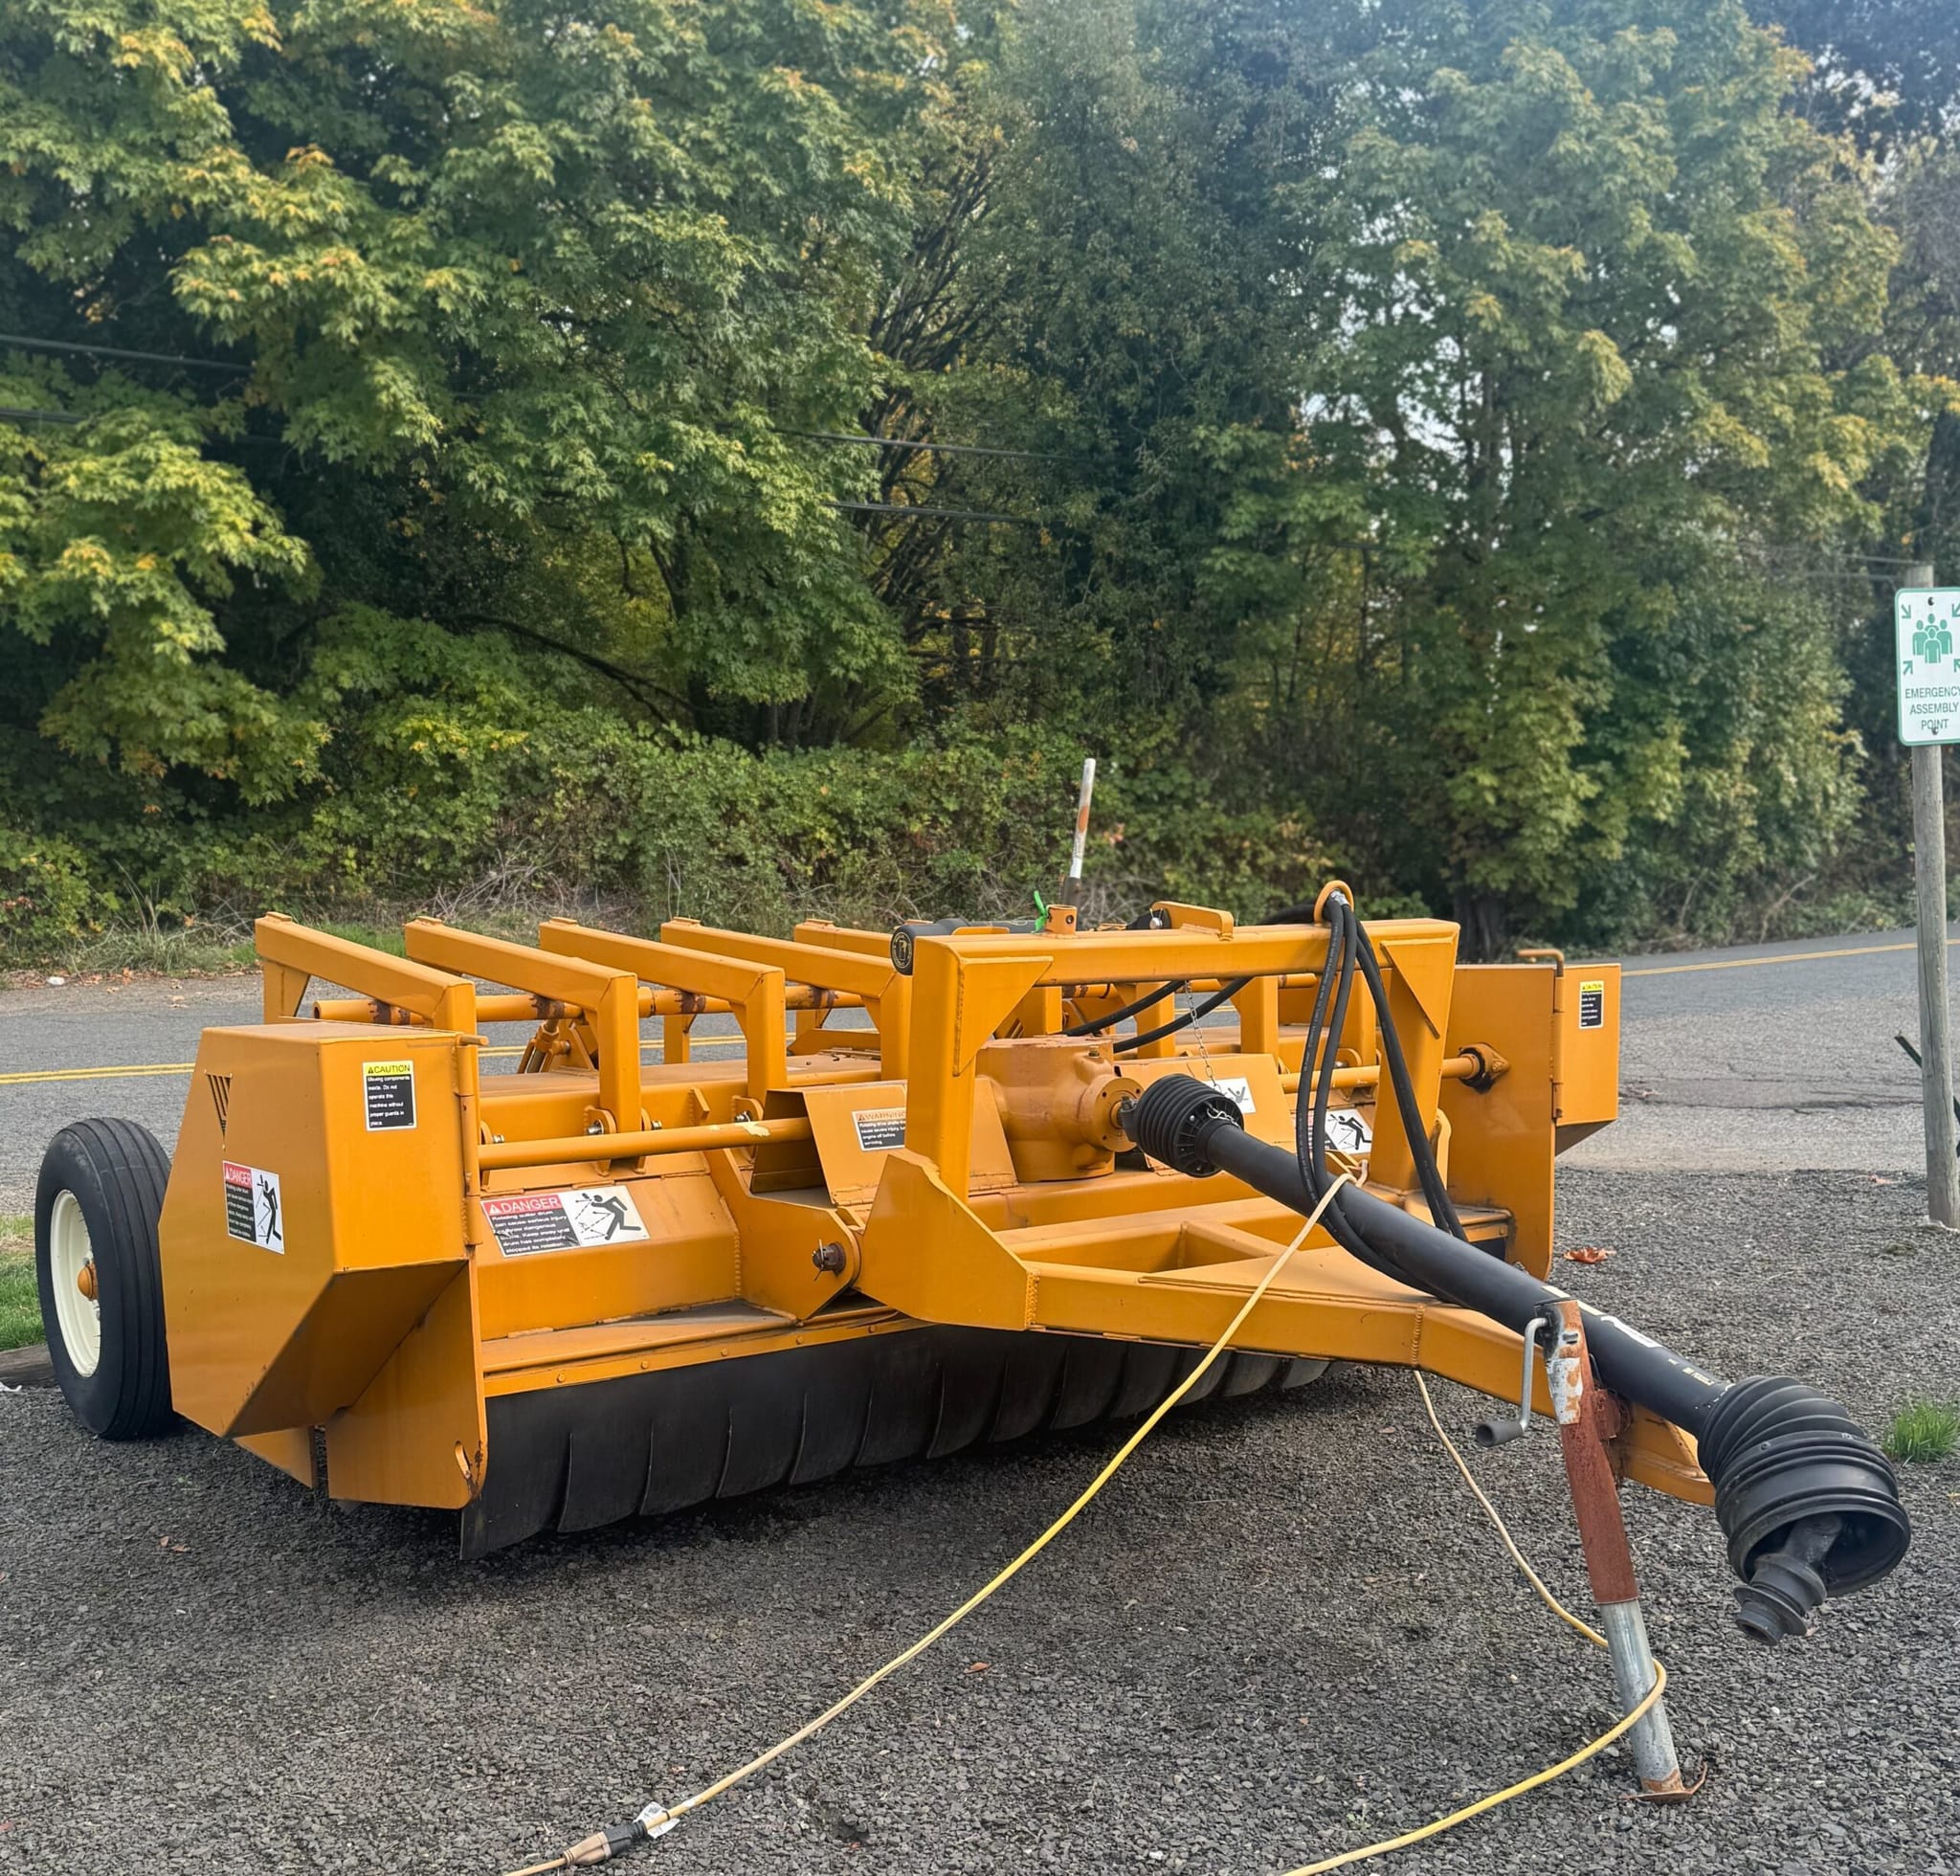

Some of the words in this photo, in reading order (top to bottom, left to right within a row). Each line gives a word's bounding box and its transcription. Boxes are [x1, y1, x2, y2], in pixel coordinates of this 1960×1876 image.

[1909, 702, 1959, 715] ASSEMBLY
[1921, 718, 1949, 730] POINT
[374, 1064, 410, 1074] CAUTION
[229, 1167, 252, 1187] DANGER
[501, 1196, 562, 1213] DANGER
